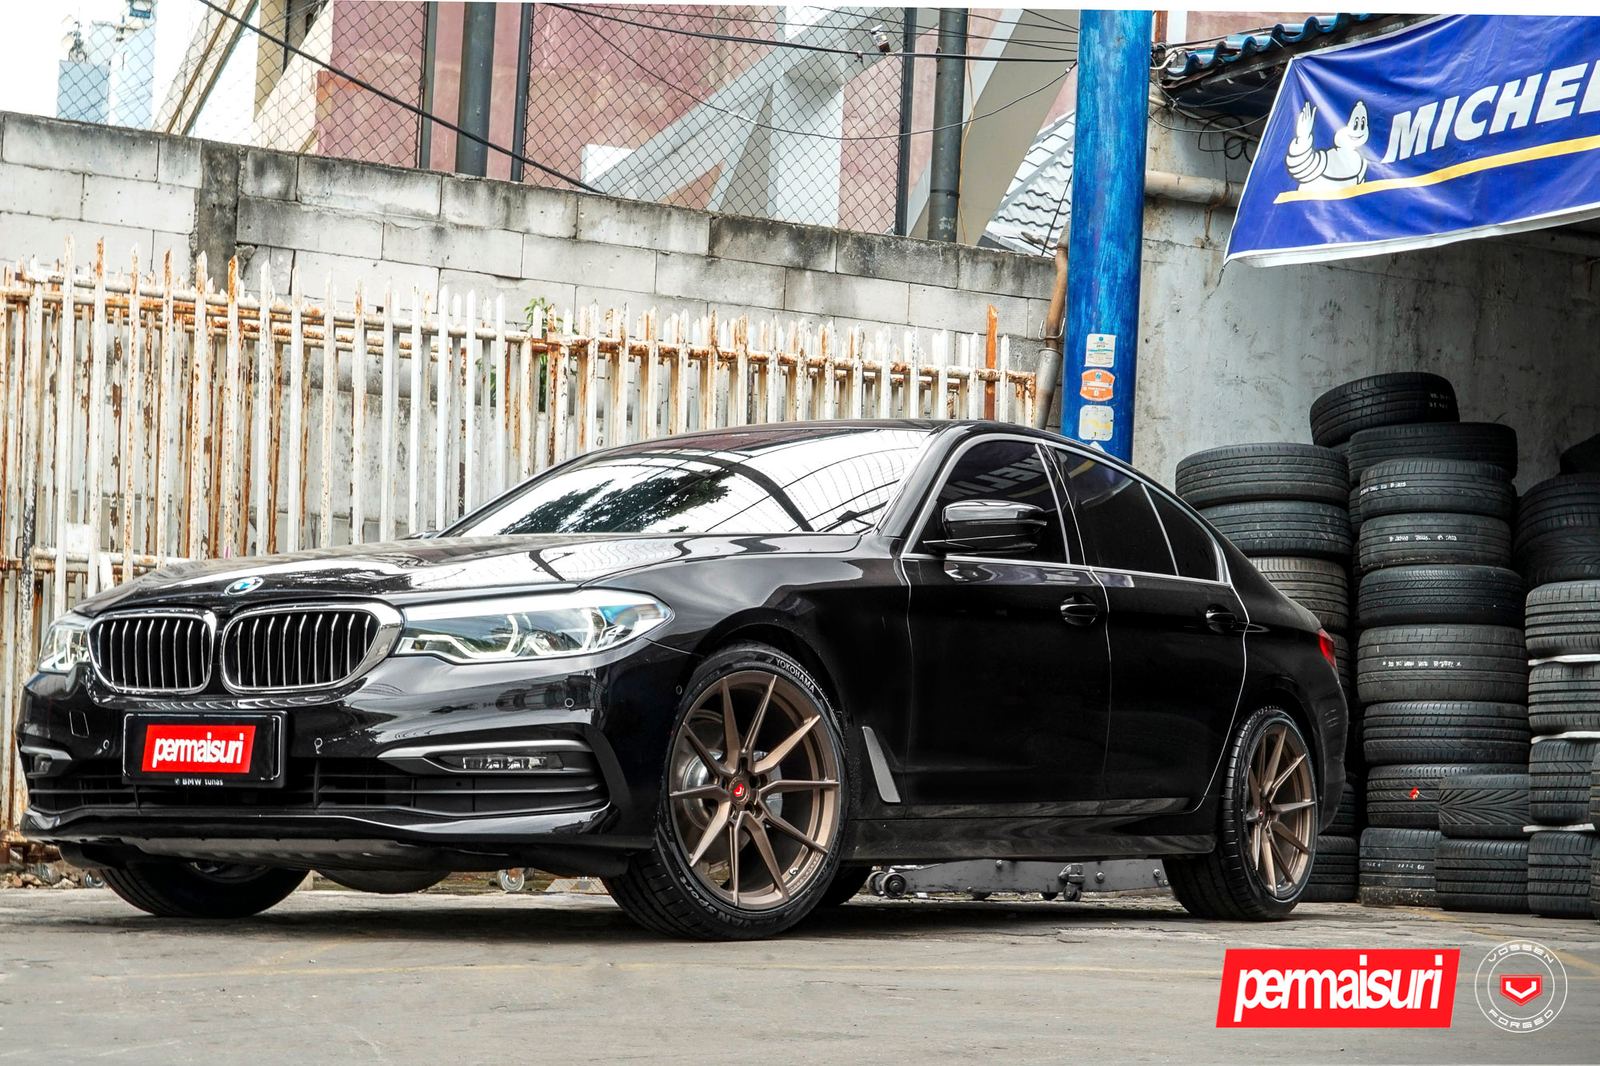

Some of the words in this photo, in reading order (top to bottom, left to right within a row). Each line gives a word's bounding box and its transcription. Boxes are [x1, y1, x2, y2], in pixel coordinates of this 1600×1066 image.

[775, 657, 815, 693] YOKOHAMA
[152, 732, 244, 768] permaisuri
[182, 778, 201, 786] BMW
